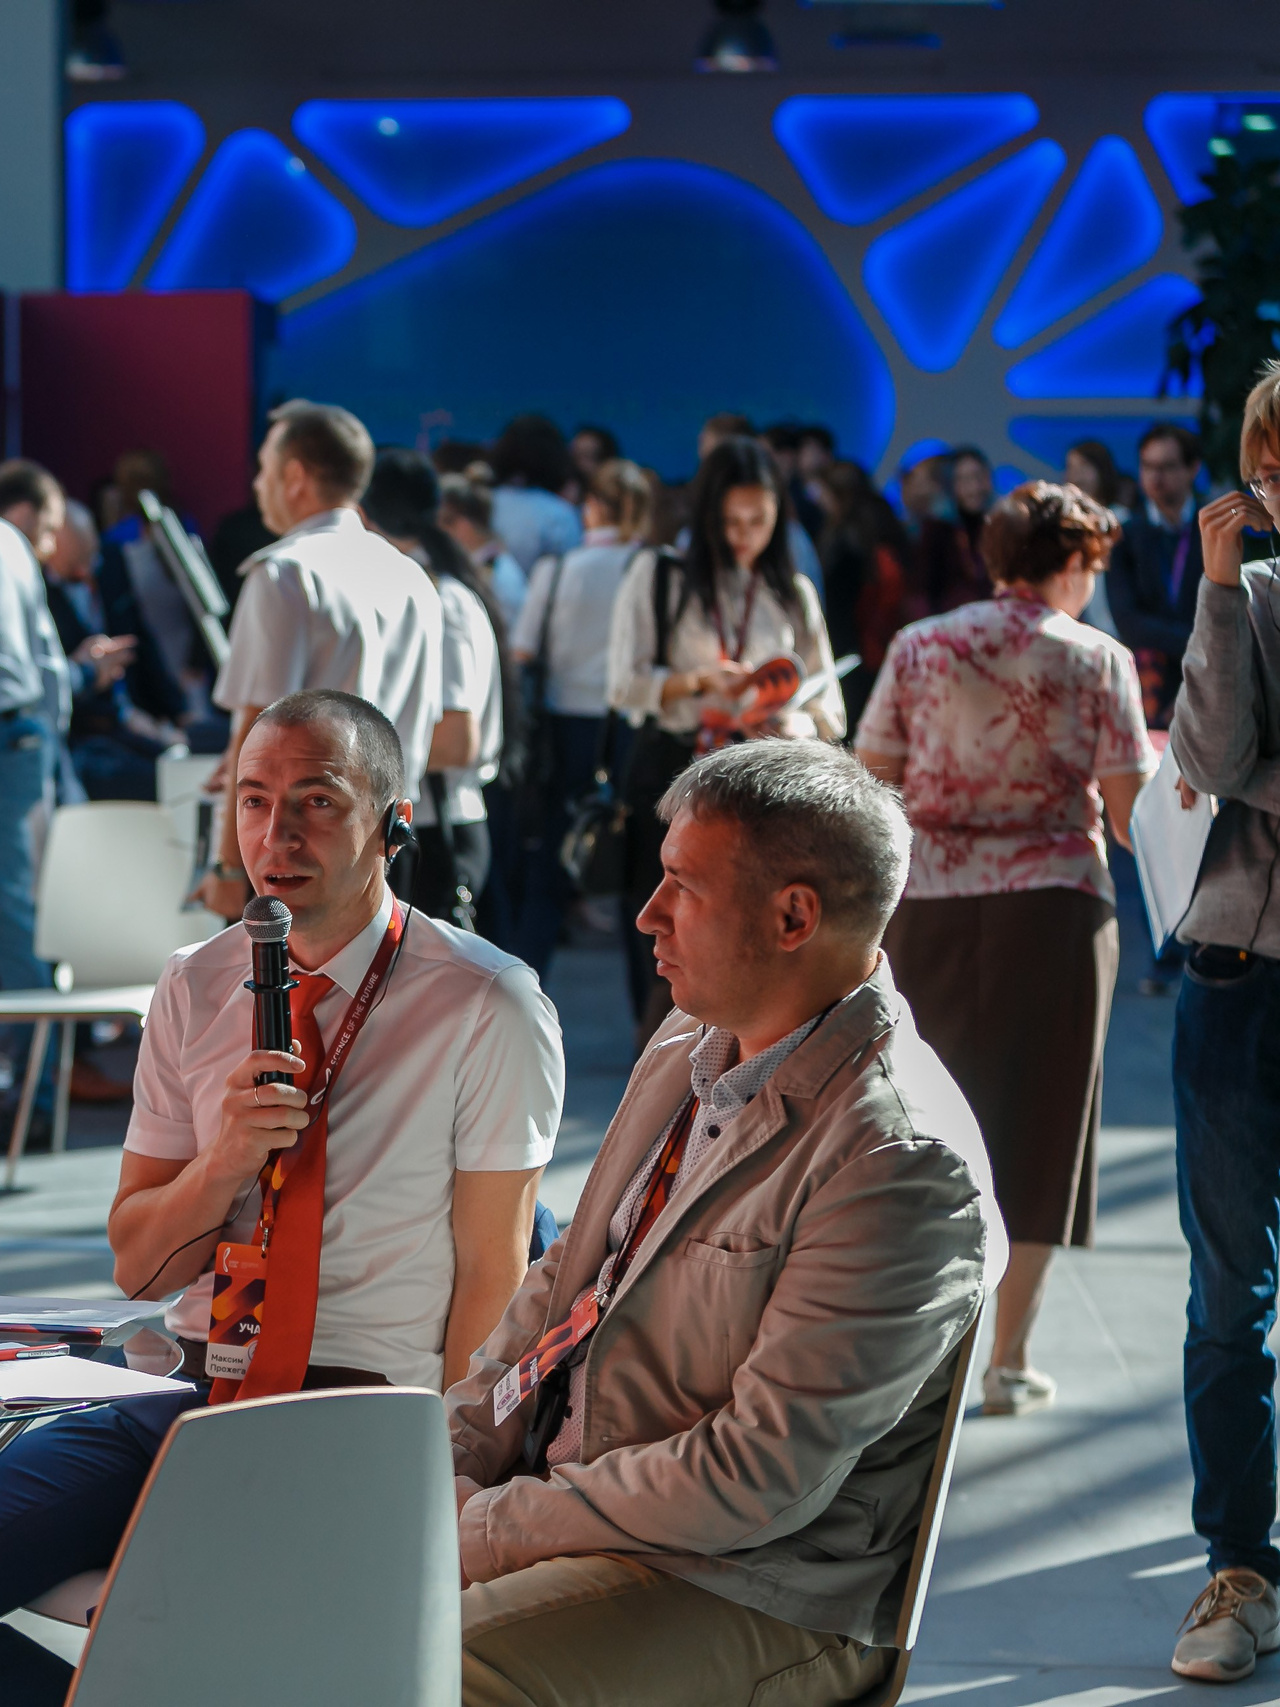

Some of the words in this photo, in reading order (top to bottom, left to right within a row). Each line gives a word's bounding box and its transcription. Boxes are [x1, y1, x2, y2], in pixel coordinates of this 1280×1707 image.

[331, 1032, 351, 1065] SCIENCE
[347, 1019, 355, 1032] OF
[352, 1003, 364, 1020] THE
[360, 972, 379, 1003] FUTURE
[211, 1353, 244, 1364] Максим
